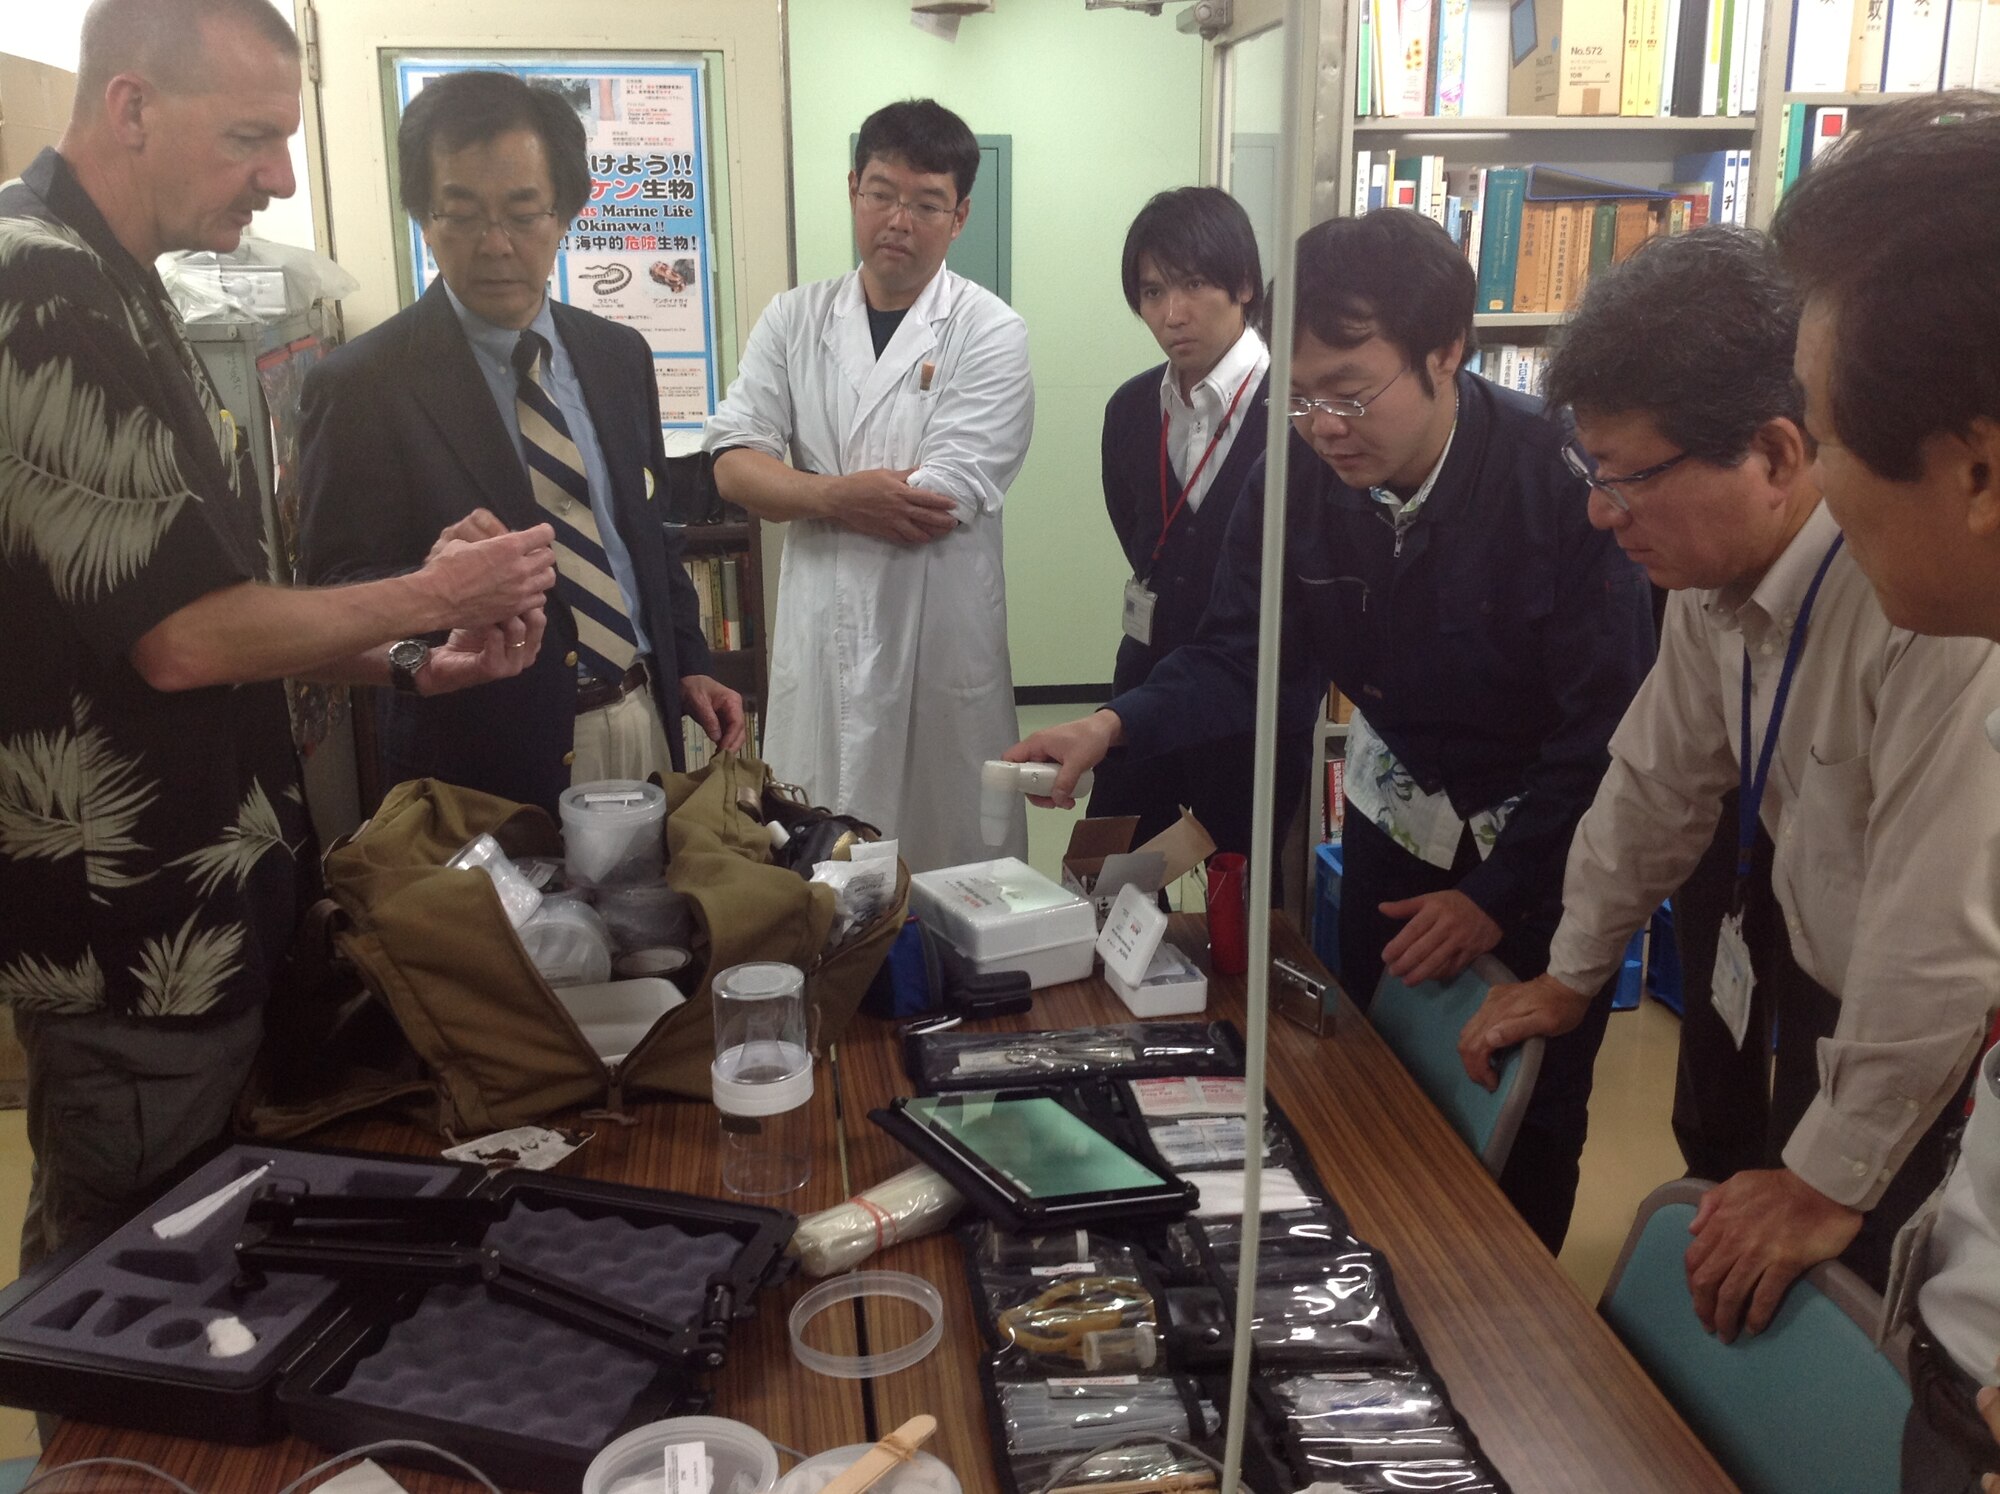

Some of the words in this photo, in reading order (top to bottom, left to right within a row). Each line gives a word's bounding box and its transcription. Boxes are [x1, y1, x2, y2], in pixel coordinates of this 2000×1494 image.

[1570, 46, 1602, 56] No.572
[591, 154, 692, 175] けよう!!
[591, 178, 694, 200] ケン生物
[1724, 179, 1735, 210] ハチ
[602, 204, 658, 217] Marine
[663, 204, 693, 217] Life
[576, 219, 651, 232] Okinawa
